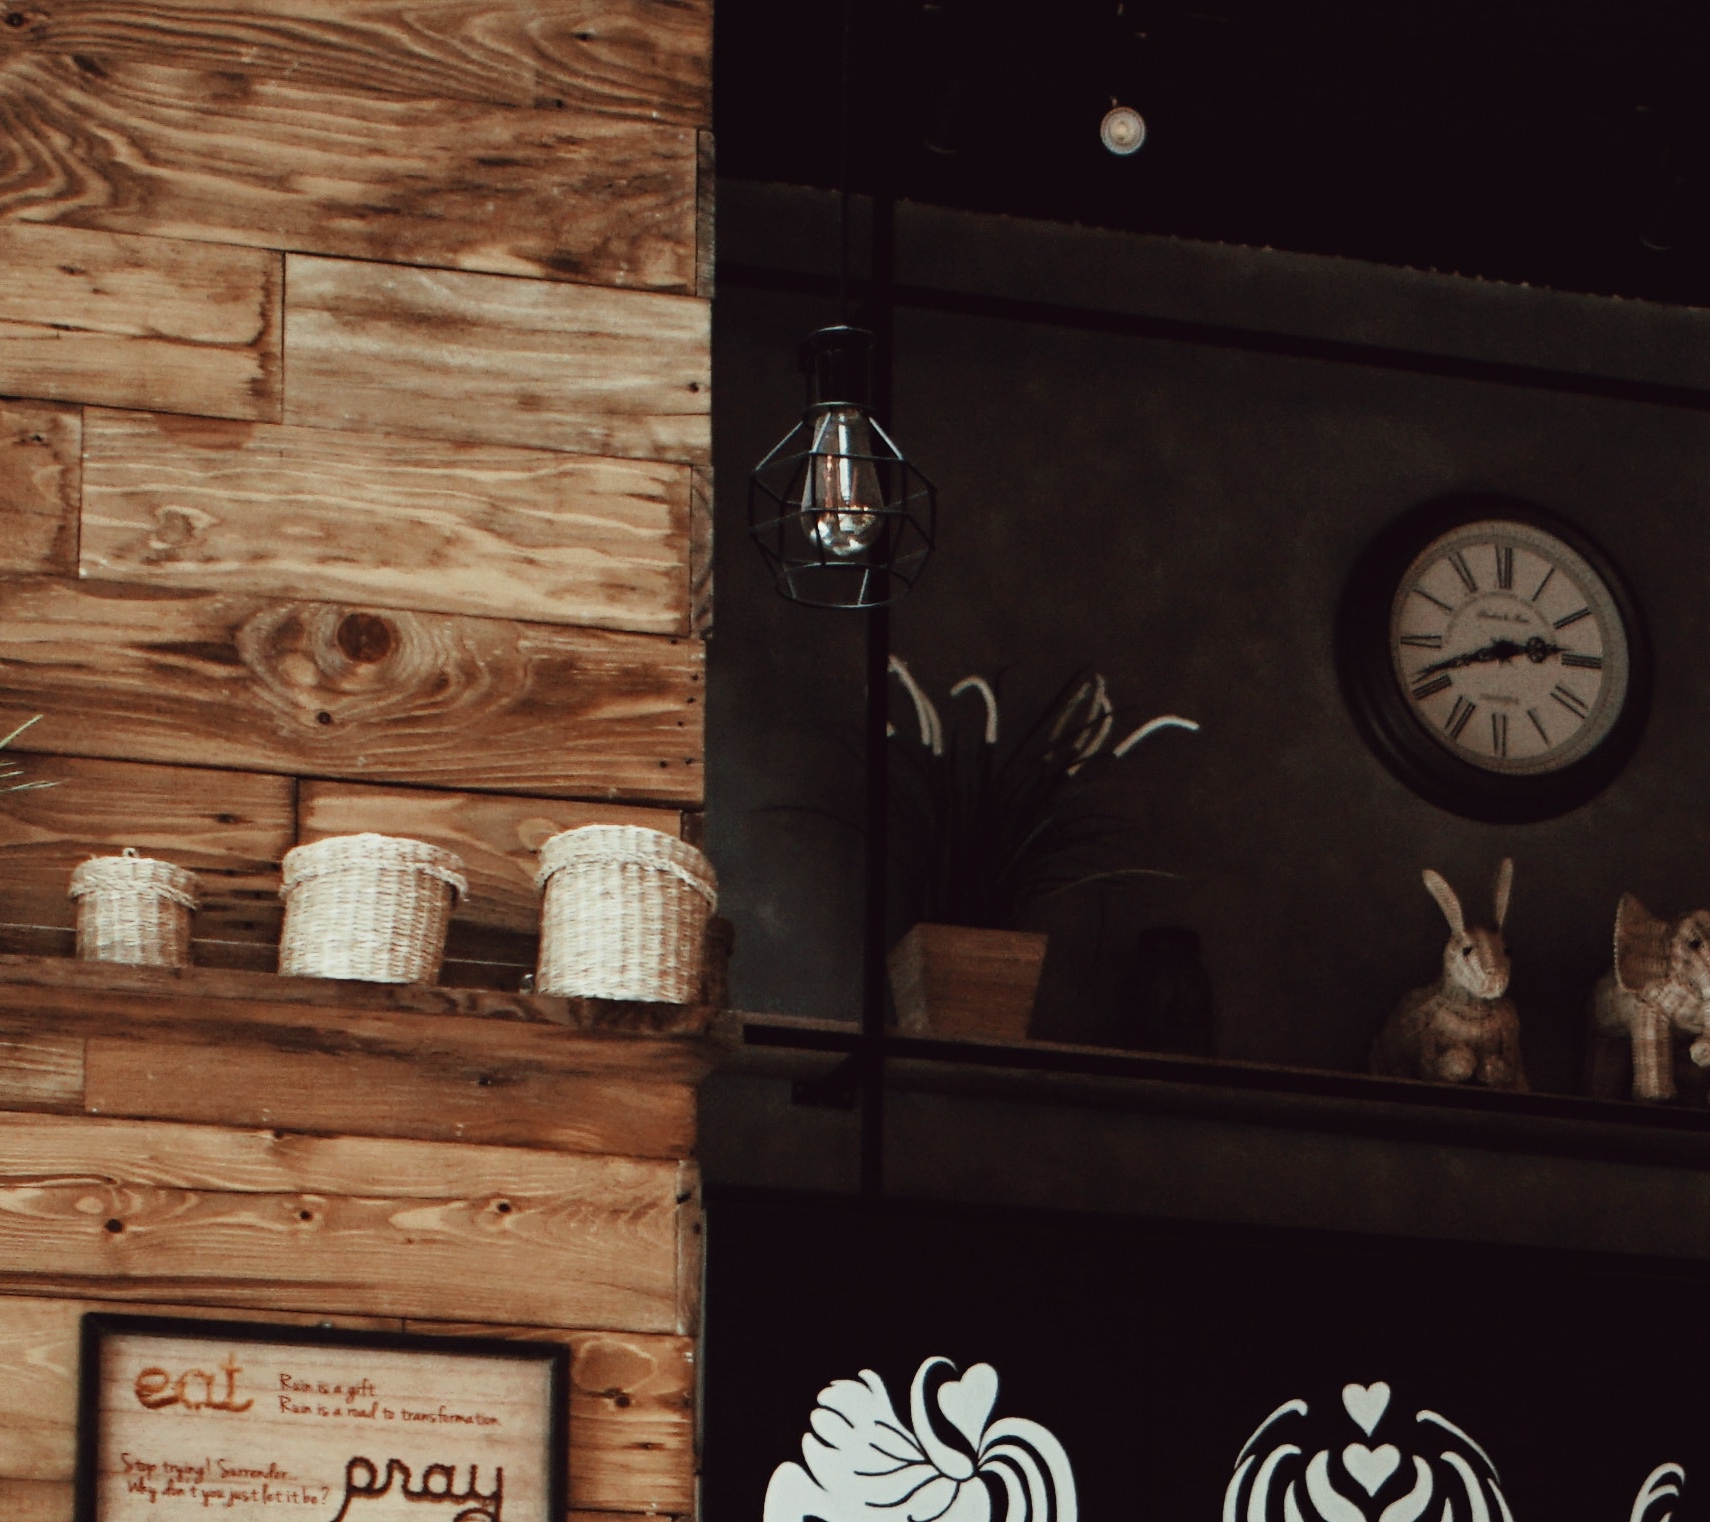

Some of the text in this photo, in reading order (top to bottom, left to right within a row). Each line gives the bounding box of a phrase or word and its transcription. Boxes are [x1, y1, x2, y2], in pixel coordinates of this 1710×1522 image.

[134, 1353, 254, 1413] eat
[279, 1373, 376, 1404] Rain is a gift
[278, 1394, 502, 1426] Rain is a road to transformation
[121, 1452, 158, 1481] Stop
[162, 1457, 212, 1485] trying!
[127, 1476, 158, 1504] Why
[201, 1488, 226, 1508] you
[227, 1487, 259, 1508] just
[262, 1482, 283, 1504] let
[286, 1489, 300, 1504] it
